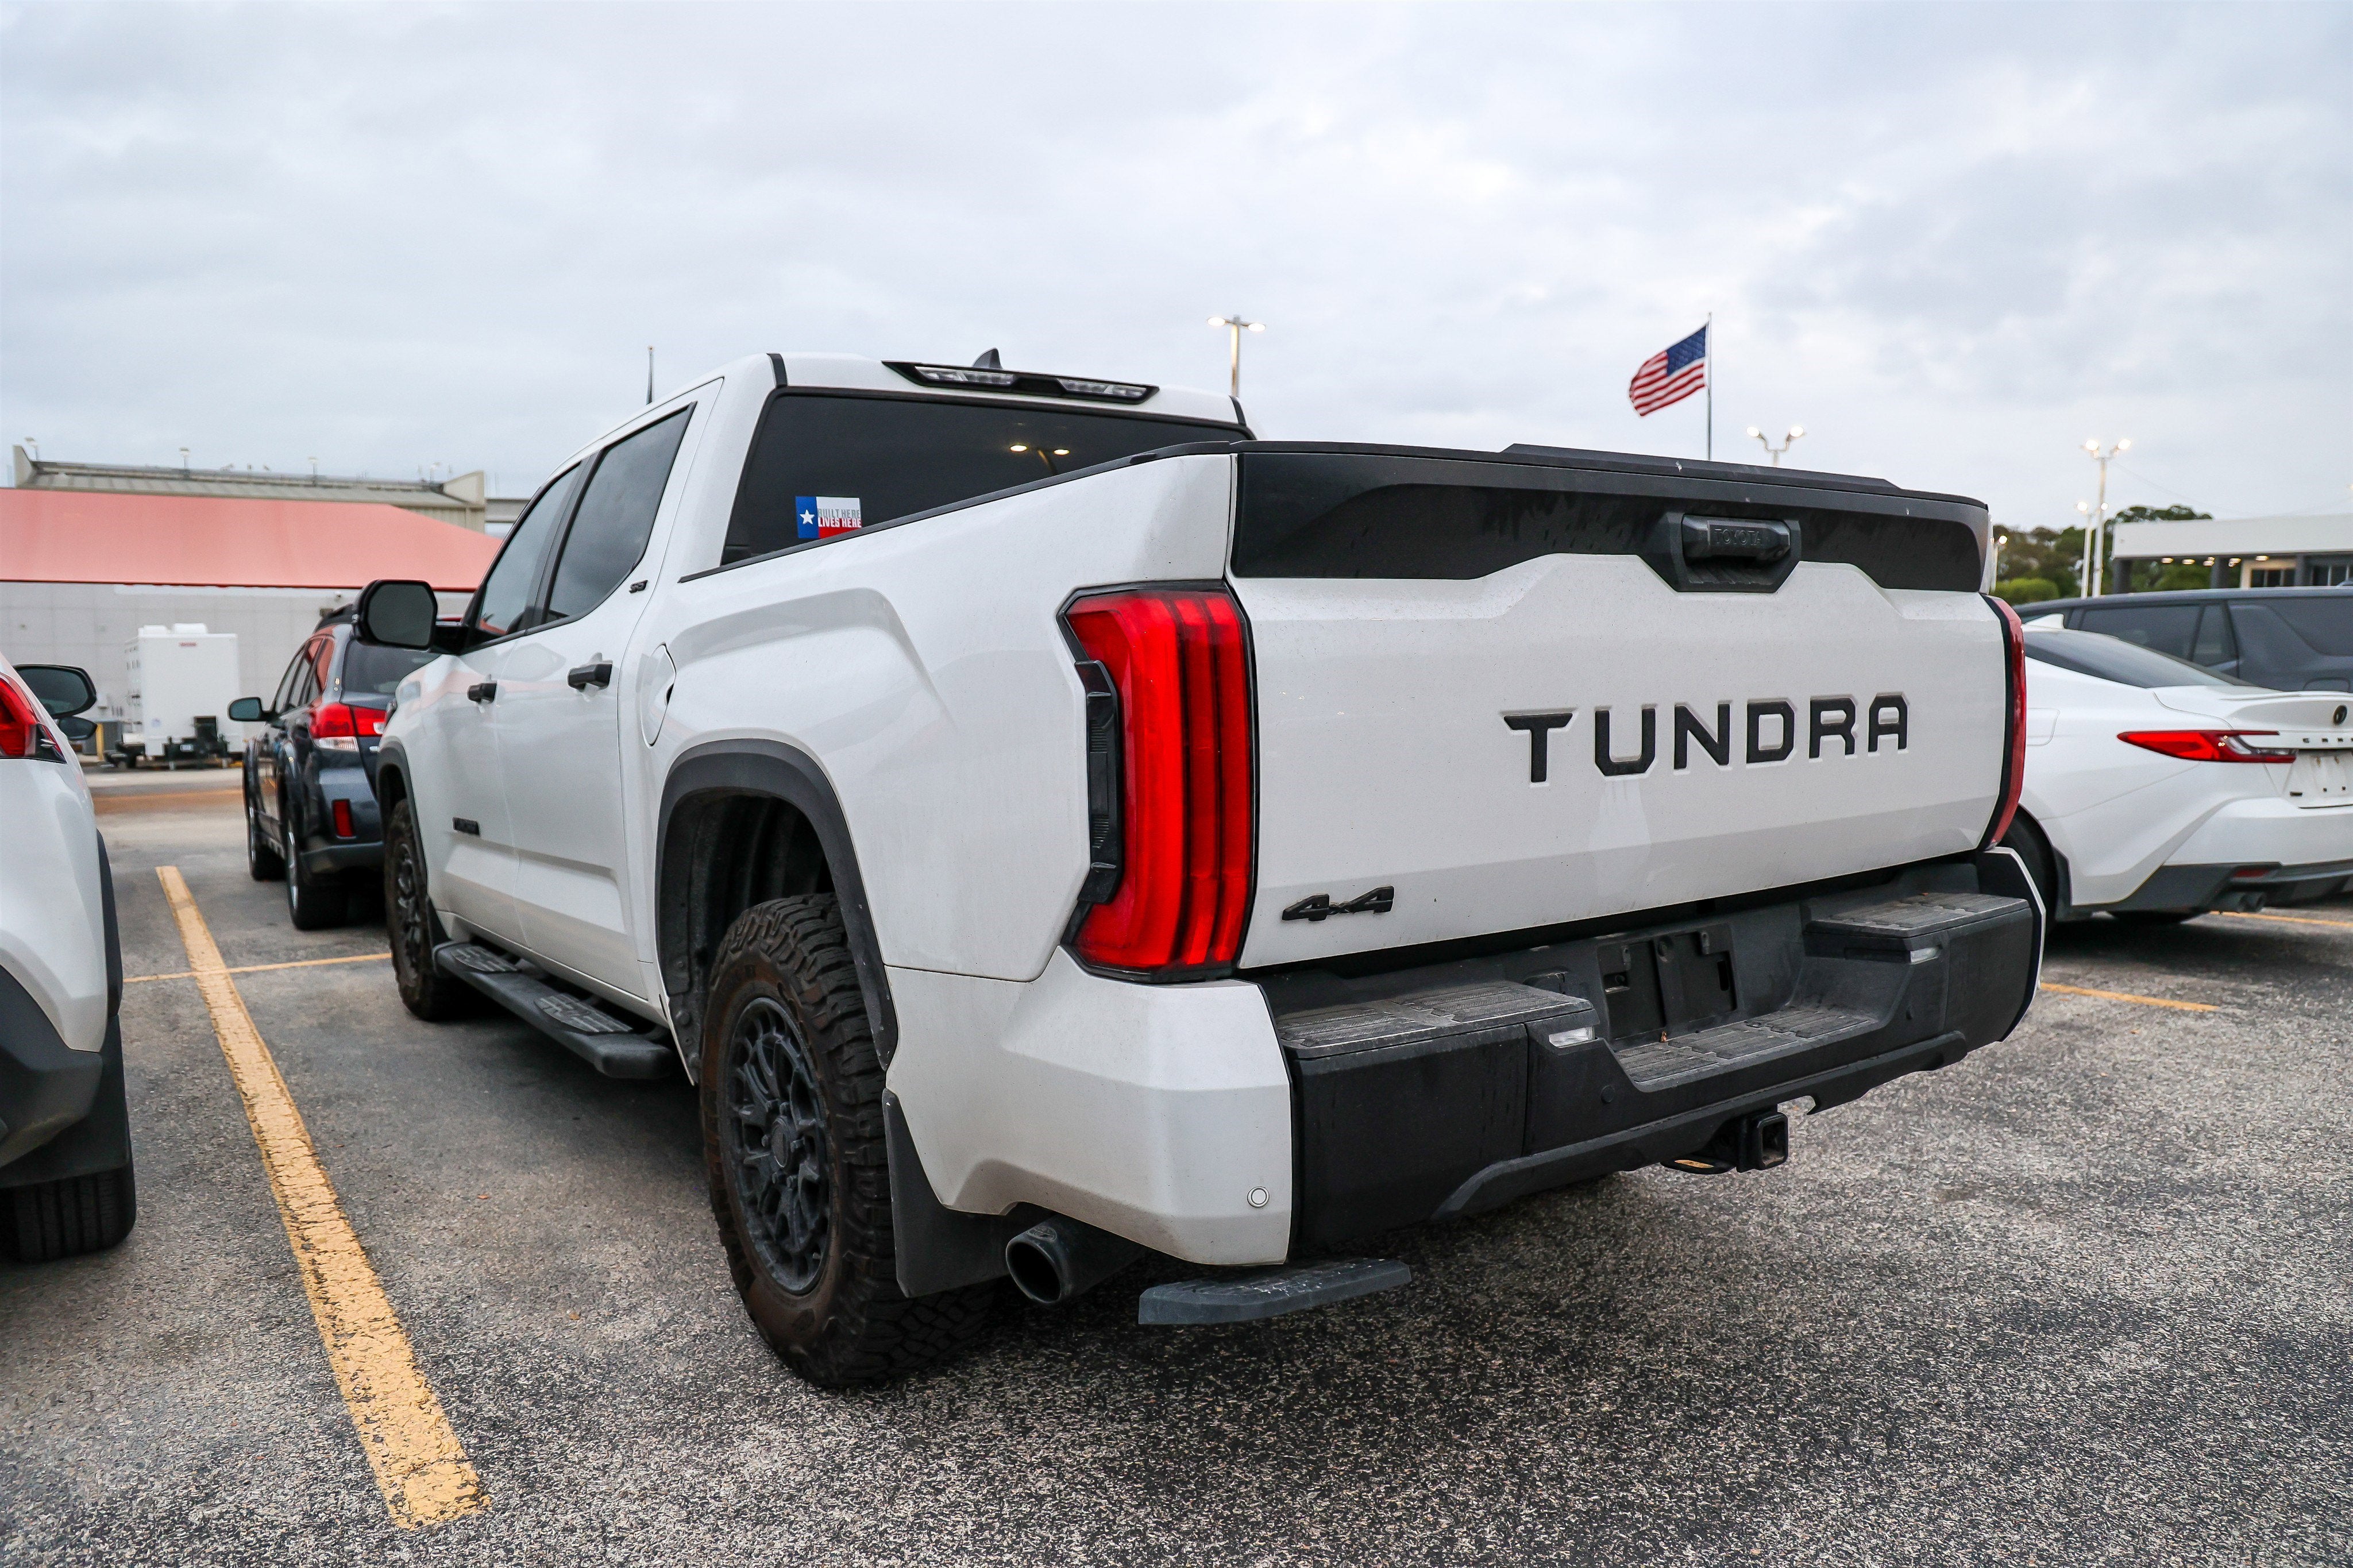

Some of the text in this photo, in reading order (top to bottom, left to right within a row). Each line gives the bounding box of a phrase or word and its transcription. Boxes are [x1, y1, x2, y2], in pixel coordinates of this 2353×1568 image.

[818, 508, 859, 518] BUILT HERE
[818, 516, 862, 527] LIVES HERE
[1714, 528, 1762, 546] TOYOTA
[1501, 693, 1909, 783] TUNDRA
